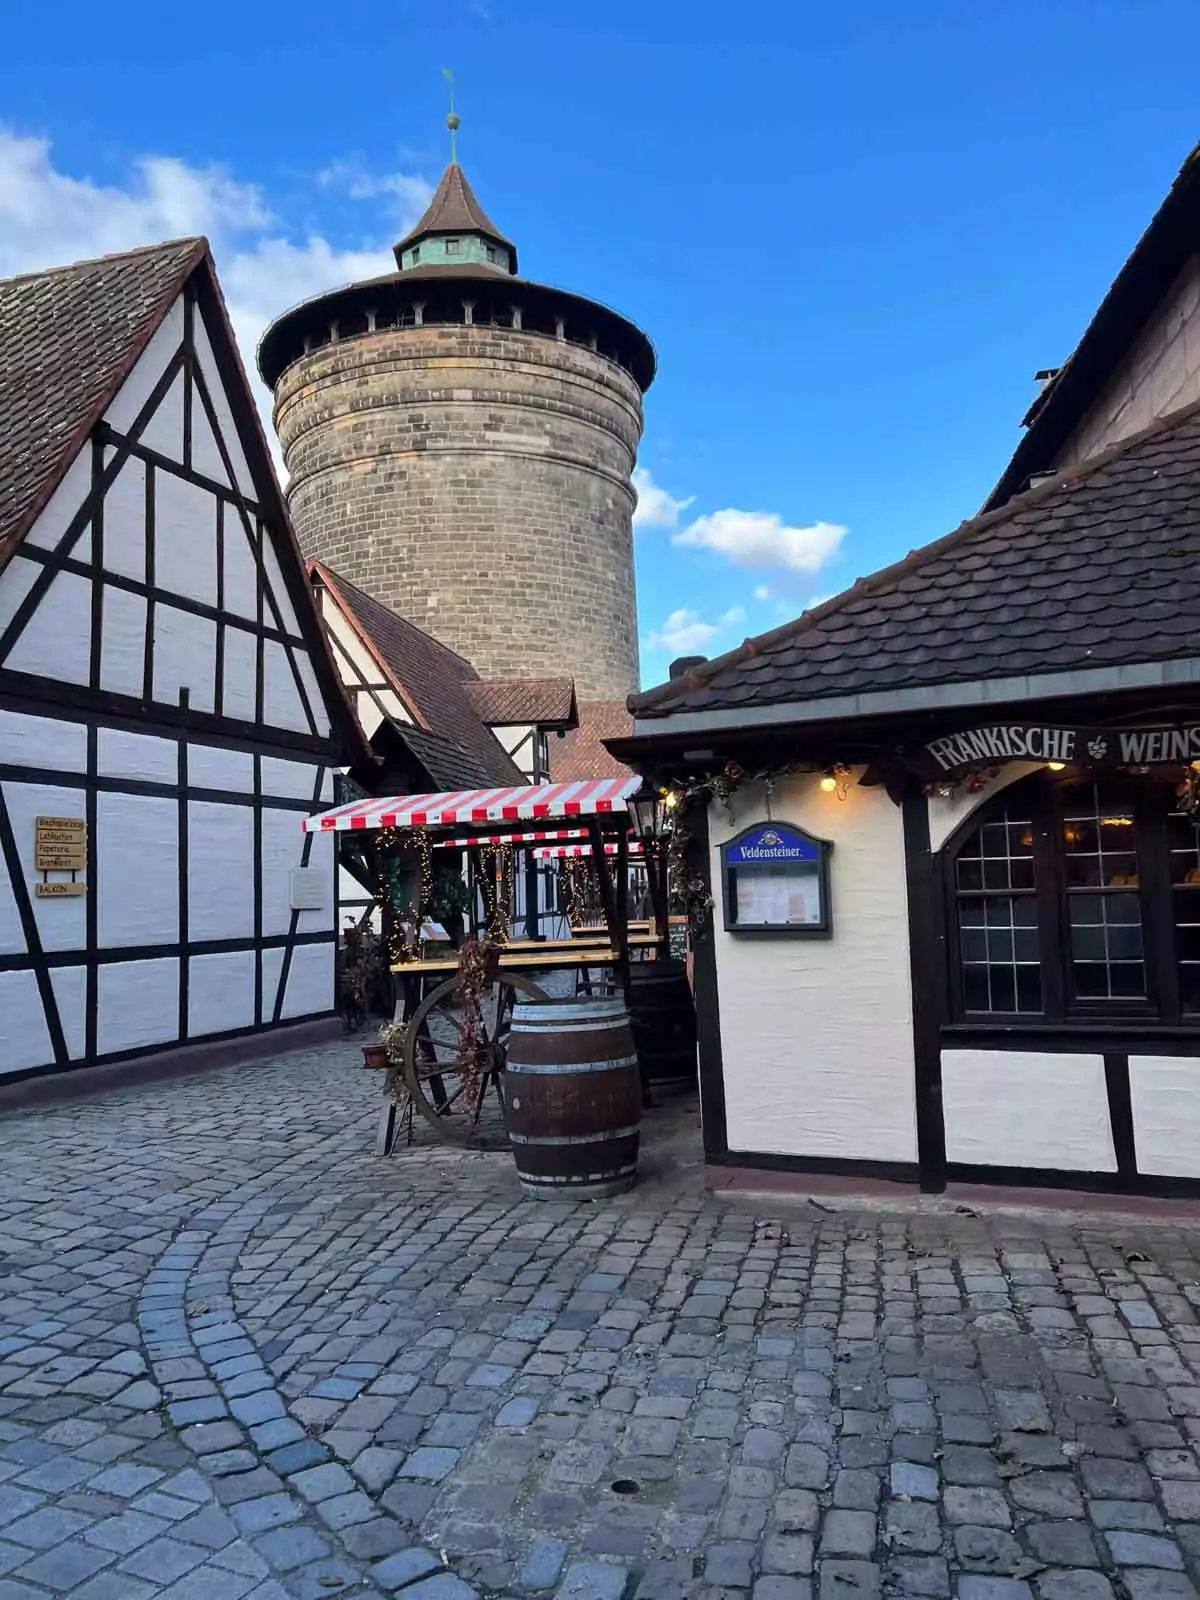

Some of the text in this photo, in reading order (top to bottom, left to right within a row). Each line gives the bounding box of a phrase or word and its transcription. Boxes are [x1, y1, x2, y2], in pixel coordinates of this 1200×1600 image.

[925, 727, 1200, 770] FRÄNKISCHE WEINS
[740, 847, 800, 859] Veldensteiner
